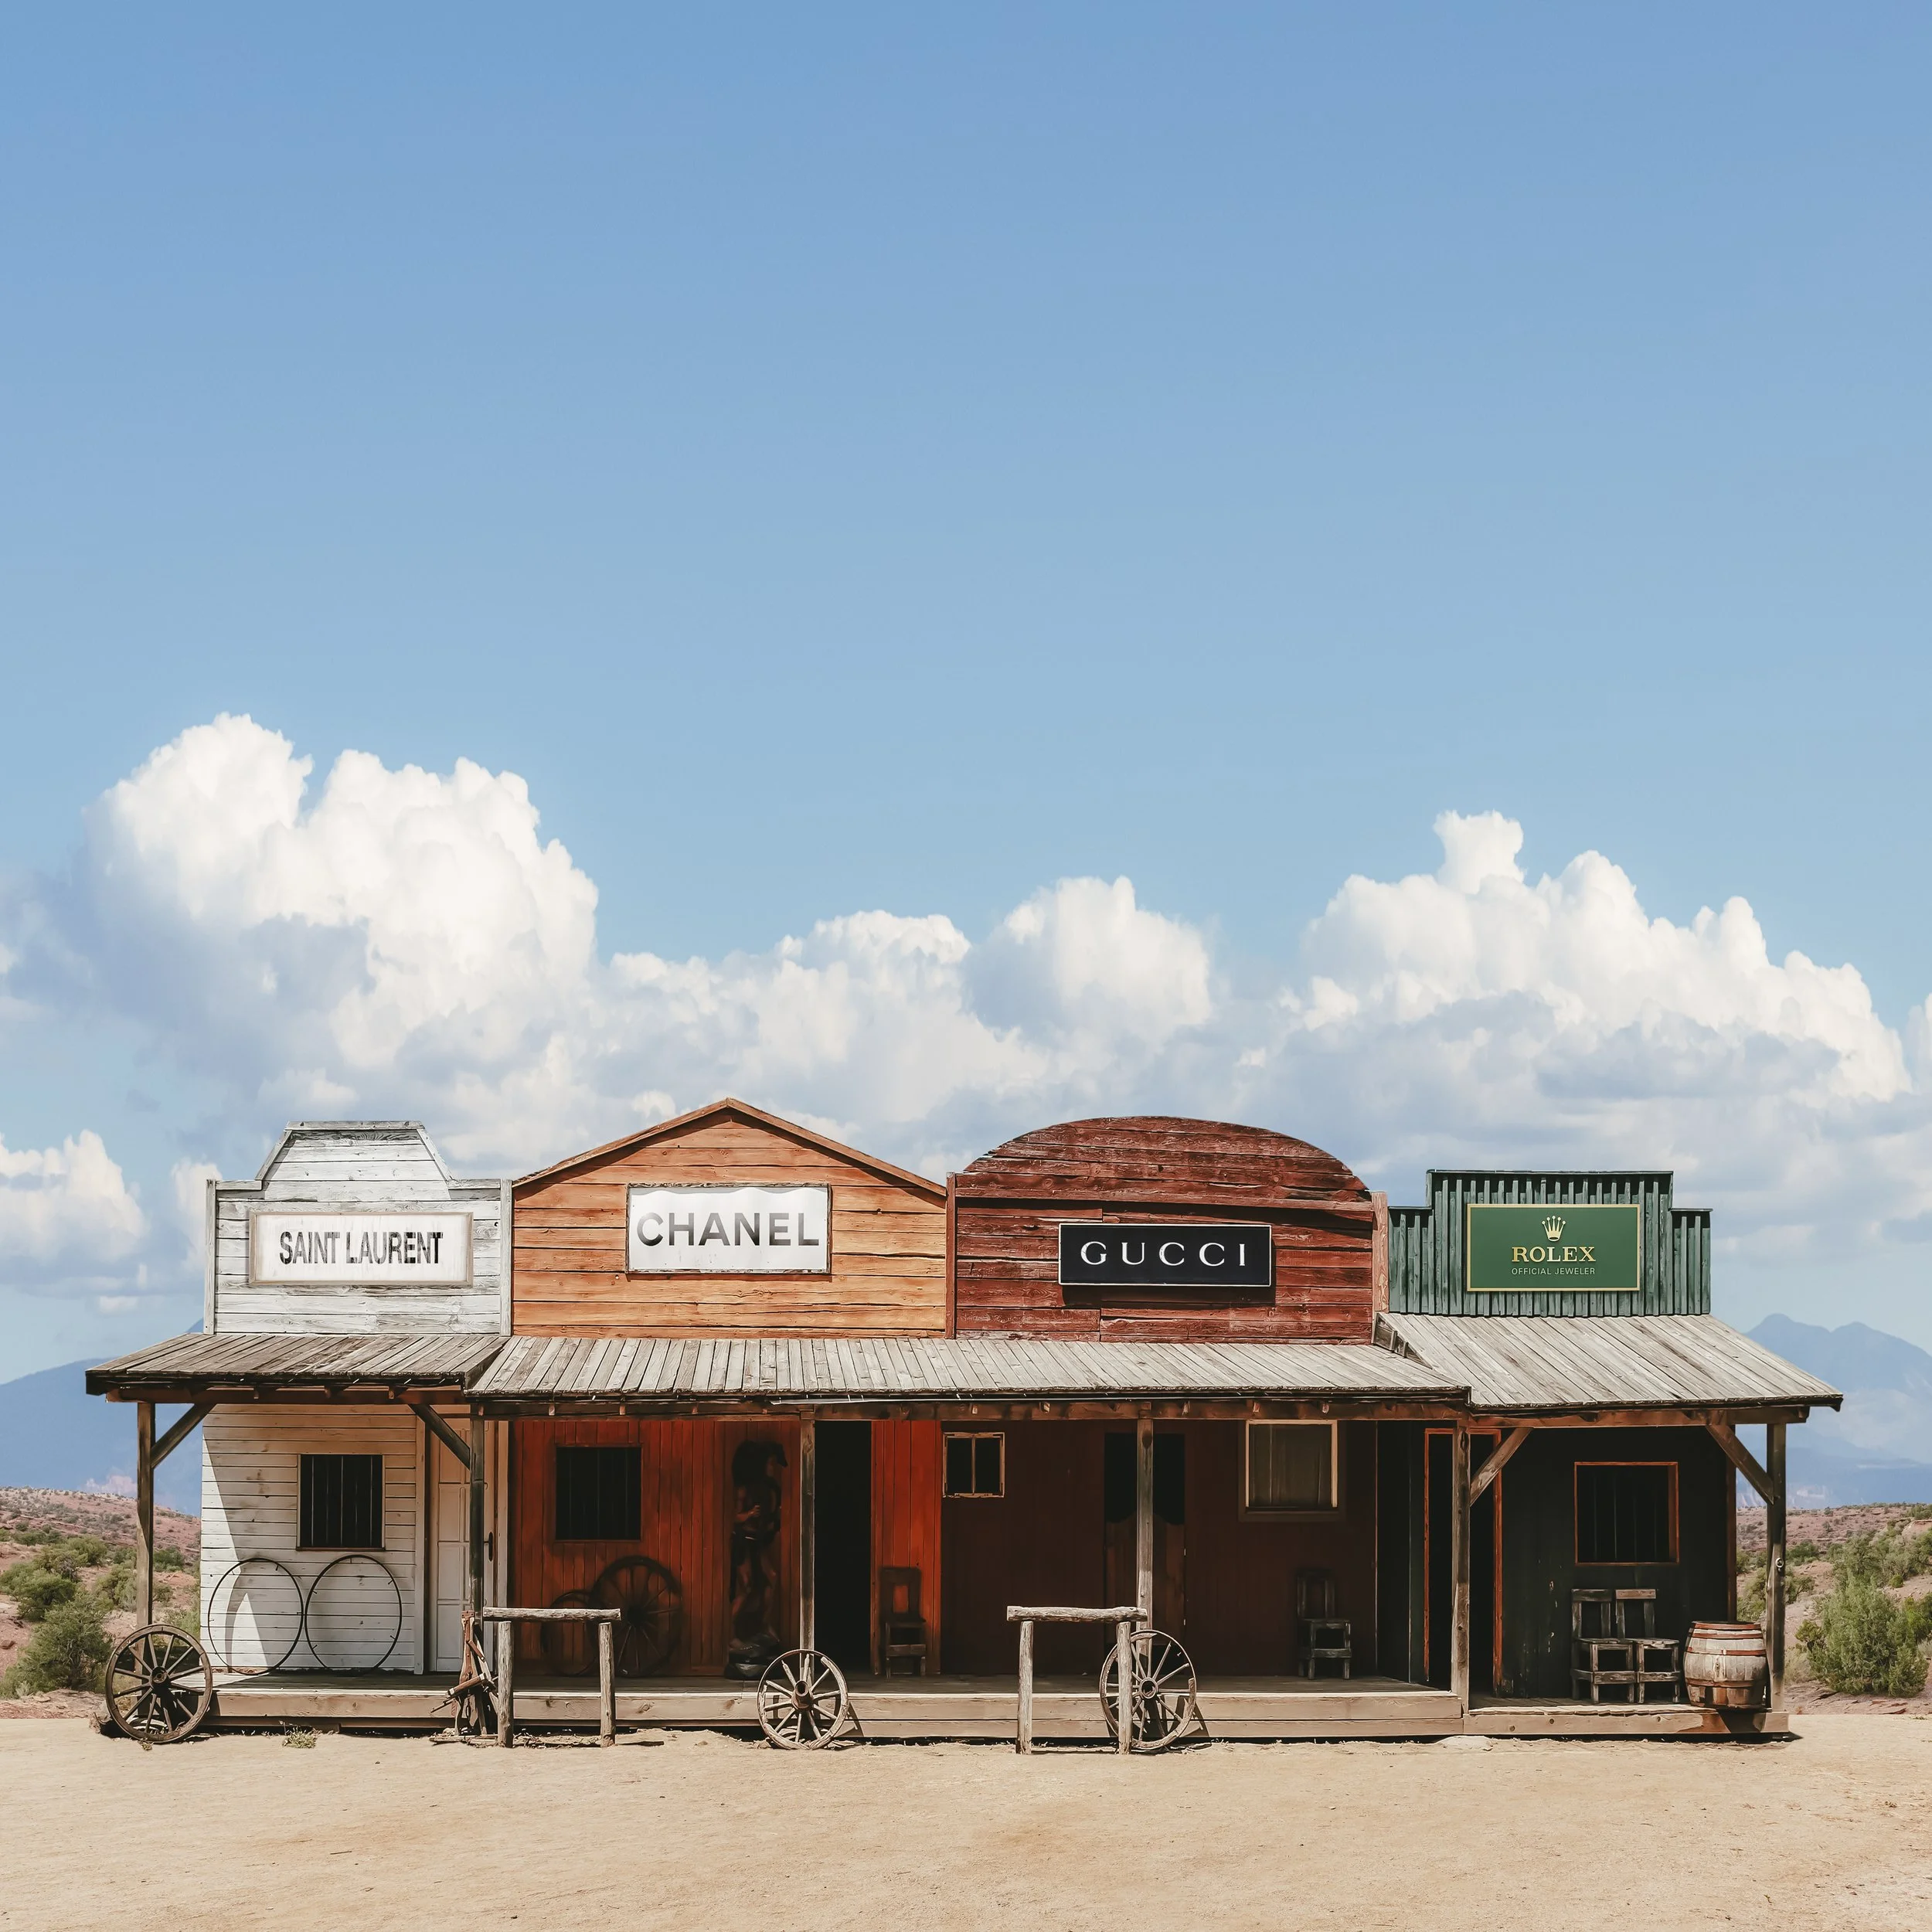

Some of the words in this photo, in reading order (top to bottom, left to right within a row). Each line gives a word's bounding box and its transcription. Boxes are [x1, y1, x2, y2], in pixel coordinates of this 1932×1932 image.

[637, 1212, 819, 1247] CHANEL
[279, 1231, 340, 1264] SAINT
[345, 1231, 444, 1264] LAURENT
[1080, 1241, 1246, 1267] GUCCI
[1511, 1246, 1597, 1263] ROLEX
